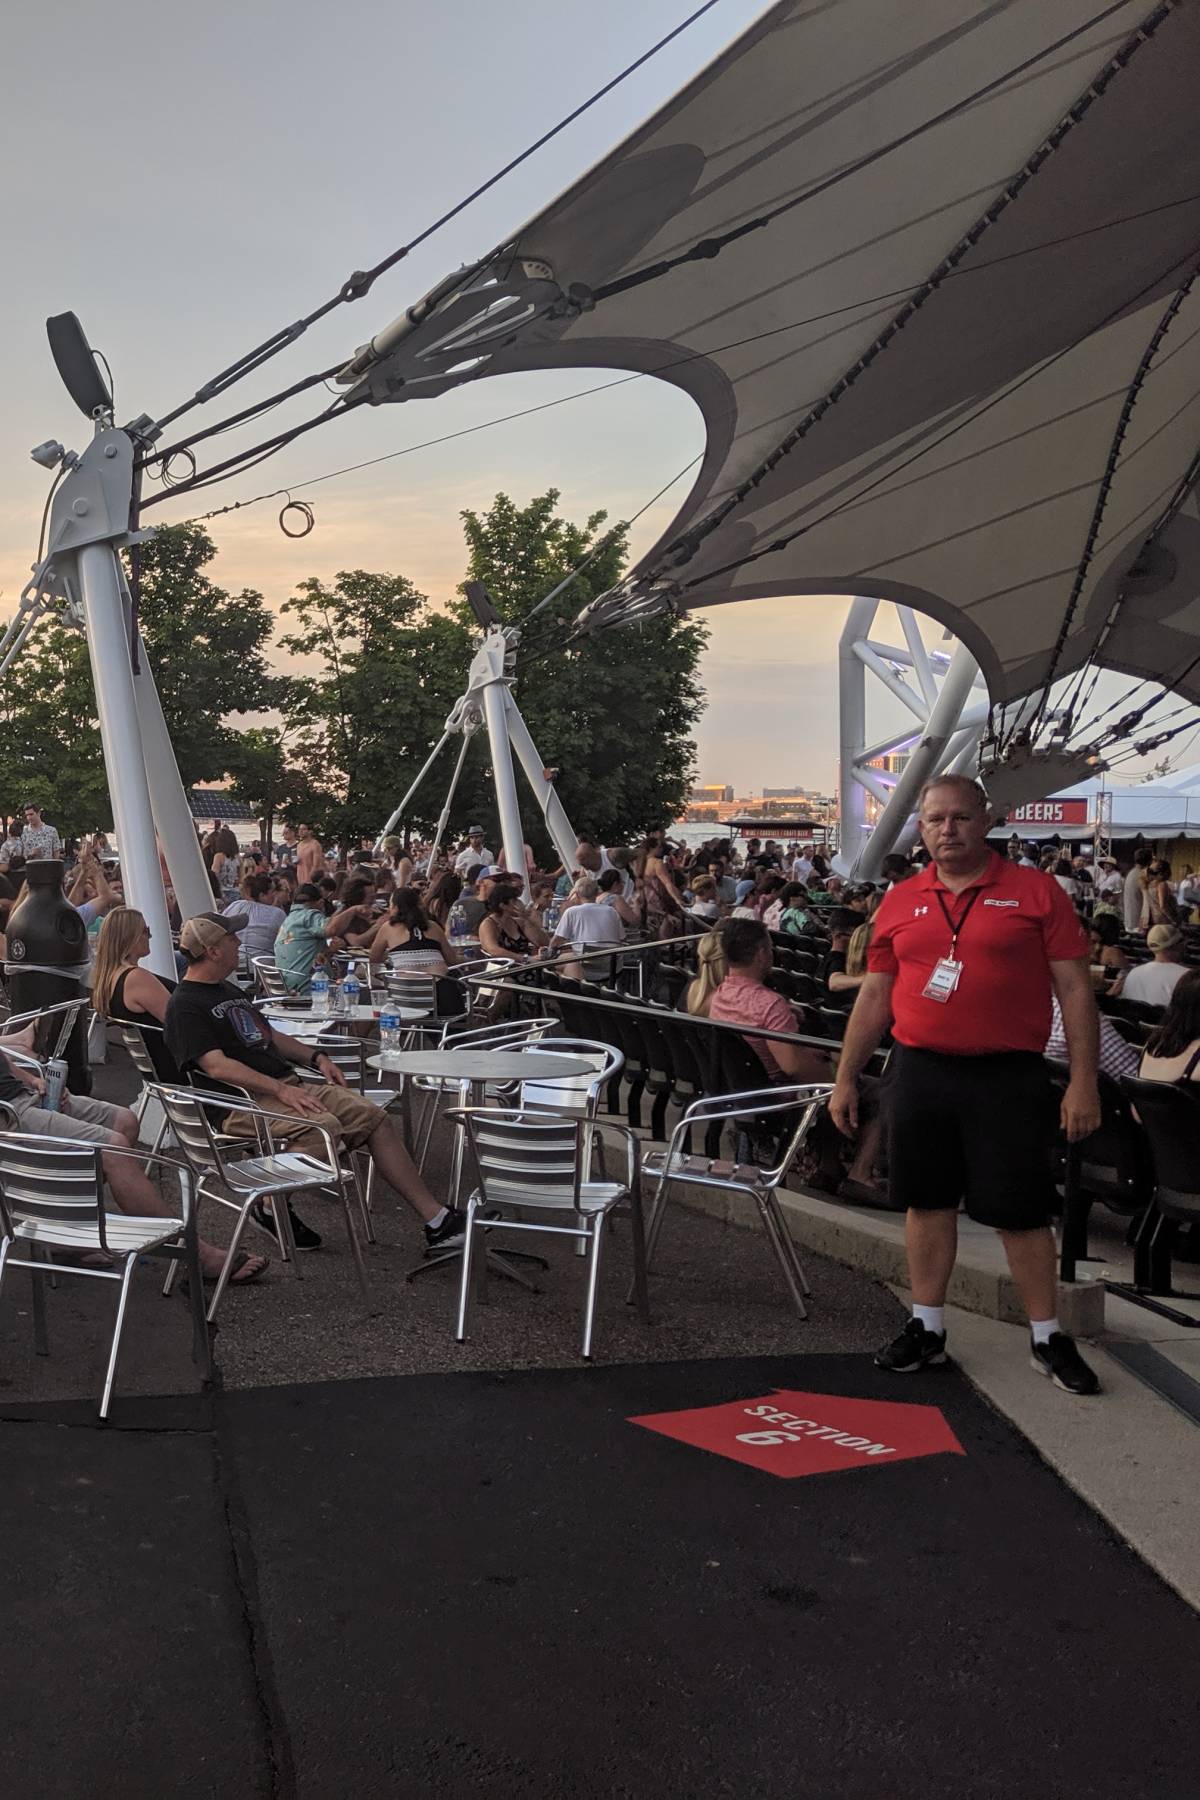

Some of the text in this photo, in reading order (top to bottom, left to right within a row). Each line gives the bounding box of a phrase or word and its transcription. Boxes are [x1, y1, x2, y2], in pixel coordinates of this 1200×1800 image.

[1015, 803, 1063, 821] BEERS
[735, 1430, 801, 1446] 6
[743, 1405, 897, 1456] SECTION
